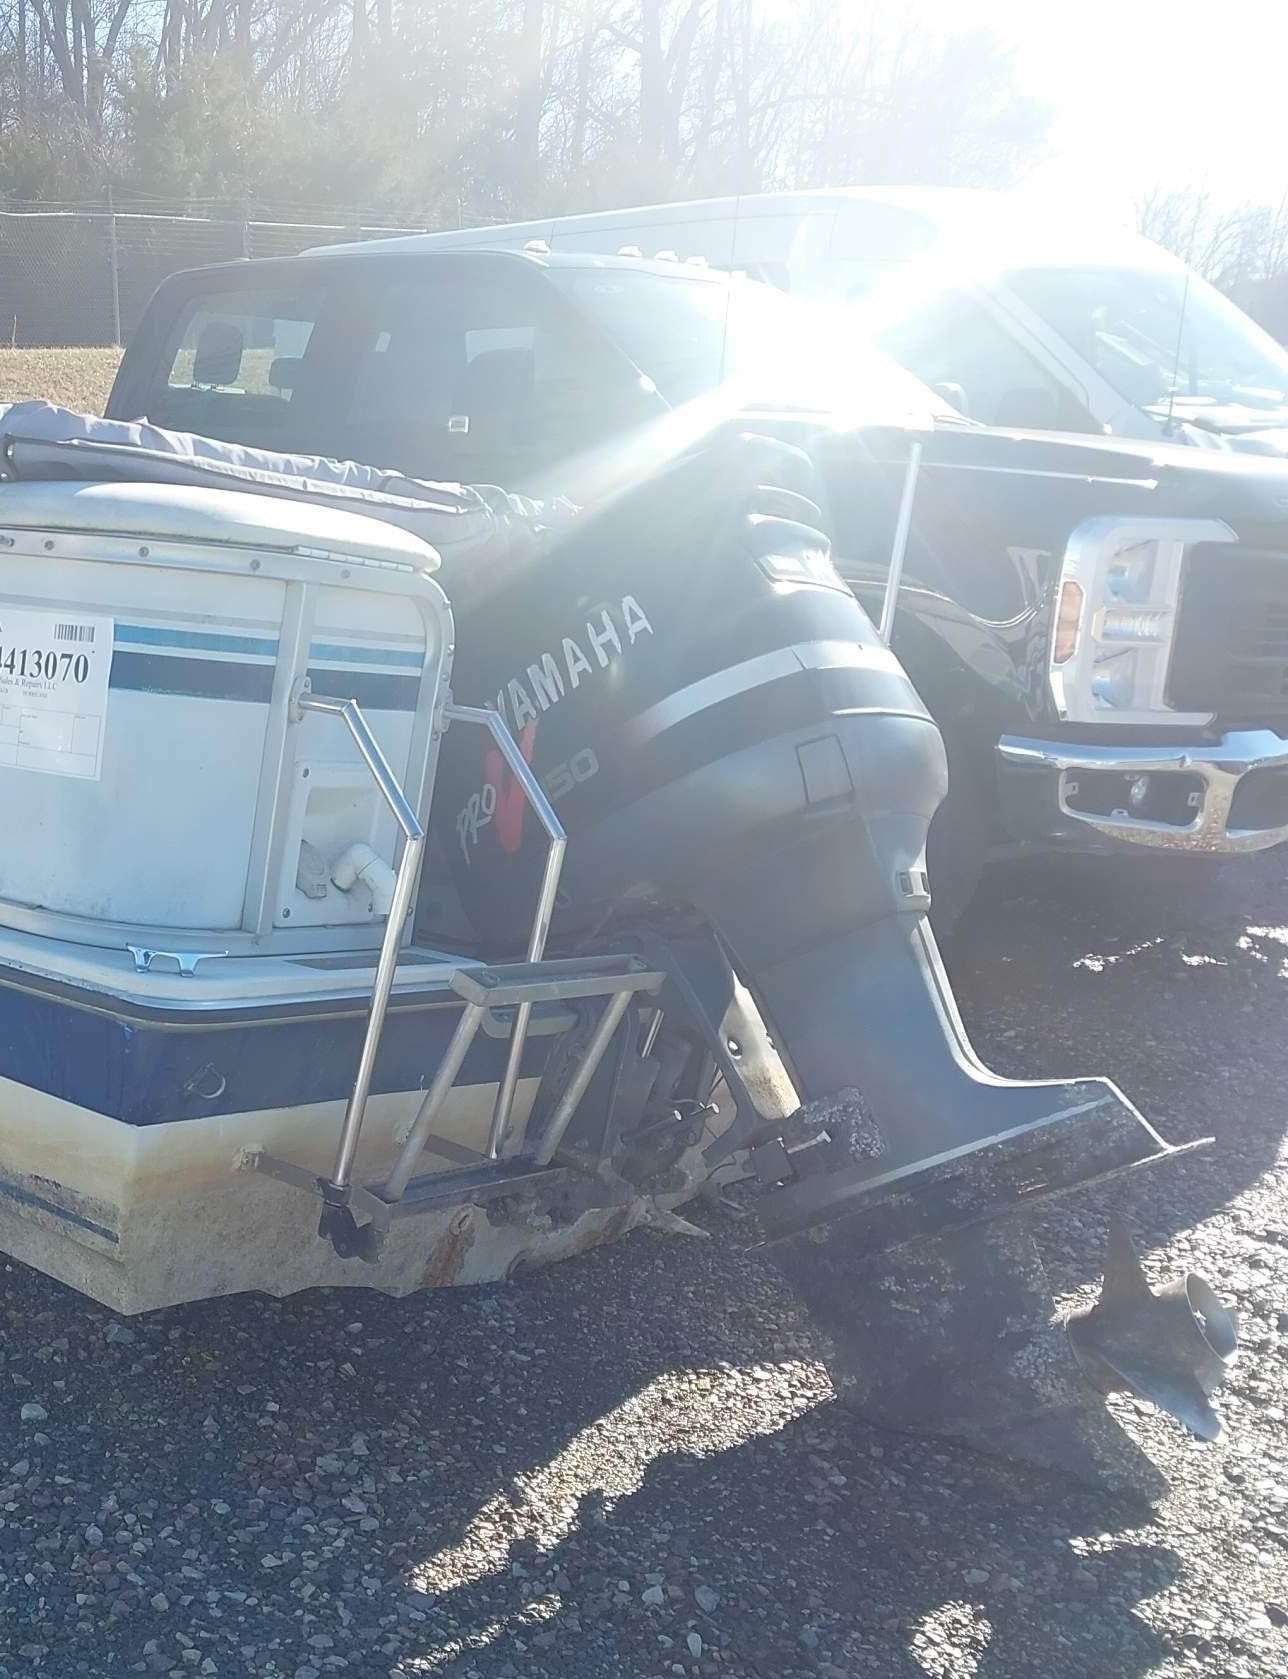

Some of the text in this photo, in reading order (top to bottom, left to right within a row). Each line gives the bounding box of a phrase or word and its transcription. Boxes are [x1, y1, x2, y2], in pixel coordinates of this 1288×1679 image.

[484, 595, 654, 731] YAMAHA
[456, 783, 496, 864] PRO
[543, 748, 600, 801] 50
